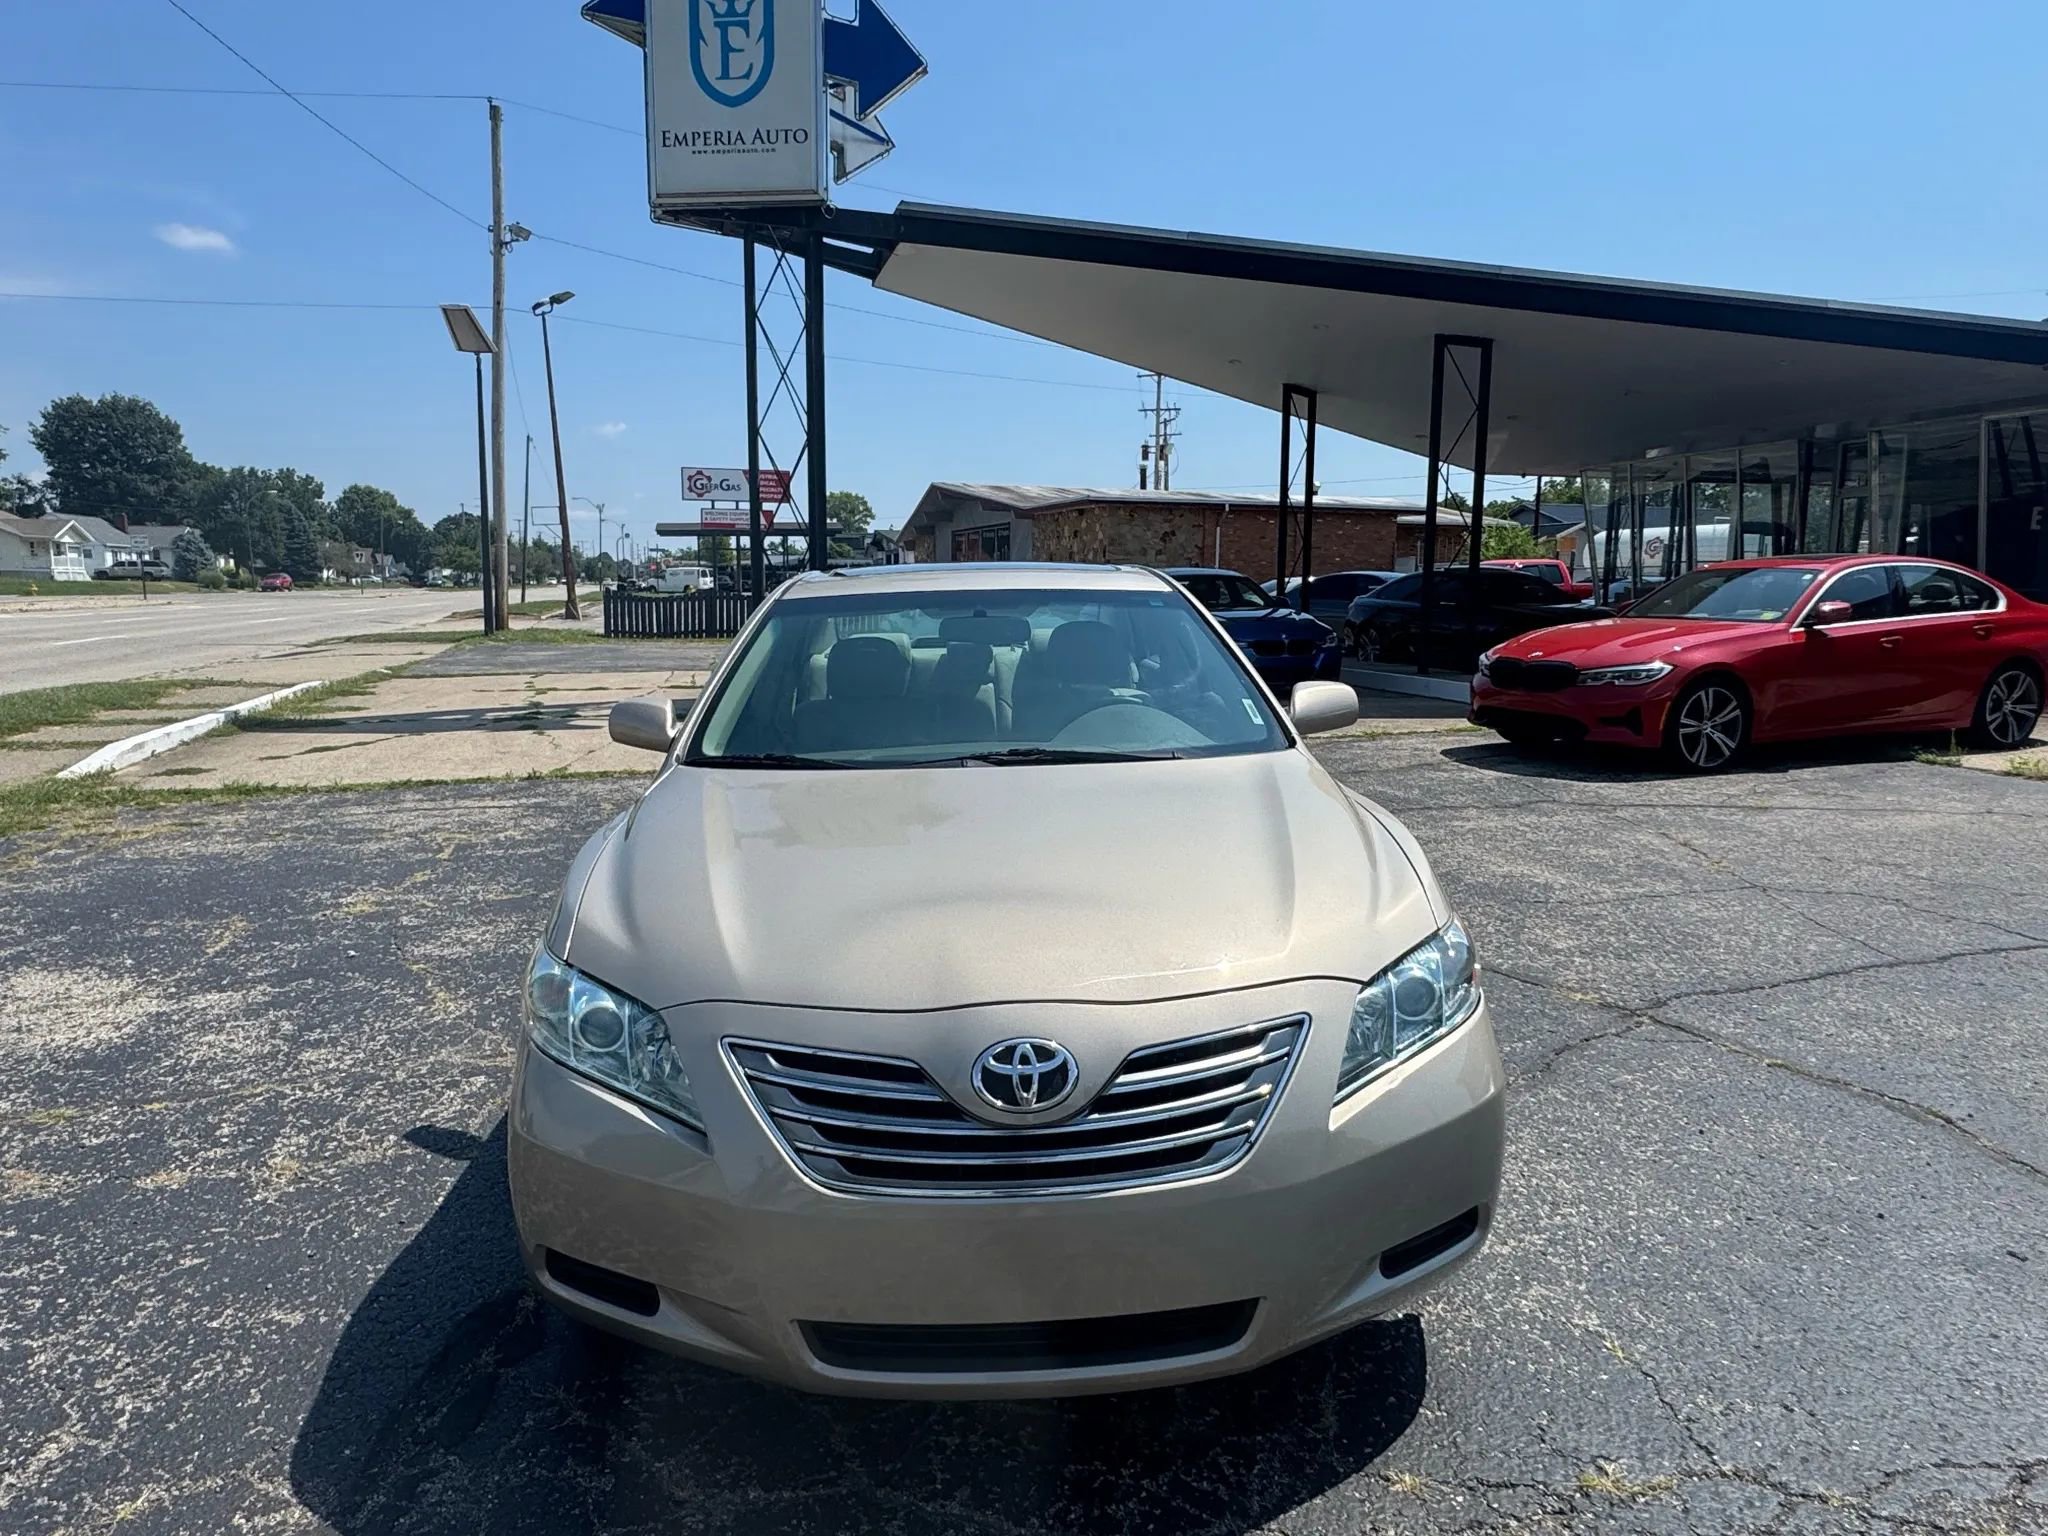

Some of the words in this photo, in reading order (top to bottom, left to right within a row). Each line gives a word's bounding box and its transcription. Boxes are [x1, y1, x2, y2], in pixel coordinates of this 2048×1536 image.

[713, 20, 753, 80] E
[661, 130, 746, 147] EMPERIA
[751, 127, 809, 146] AUTO
